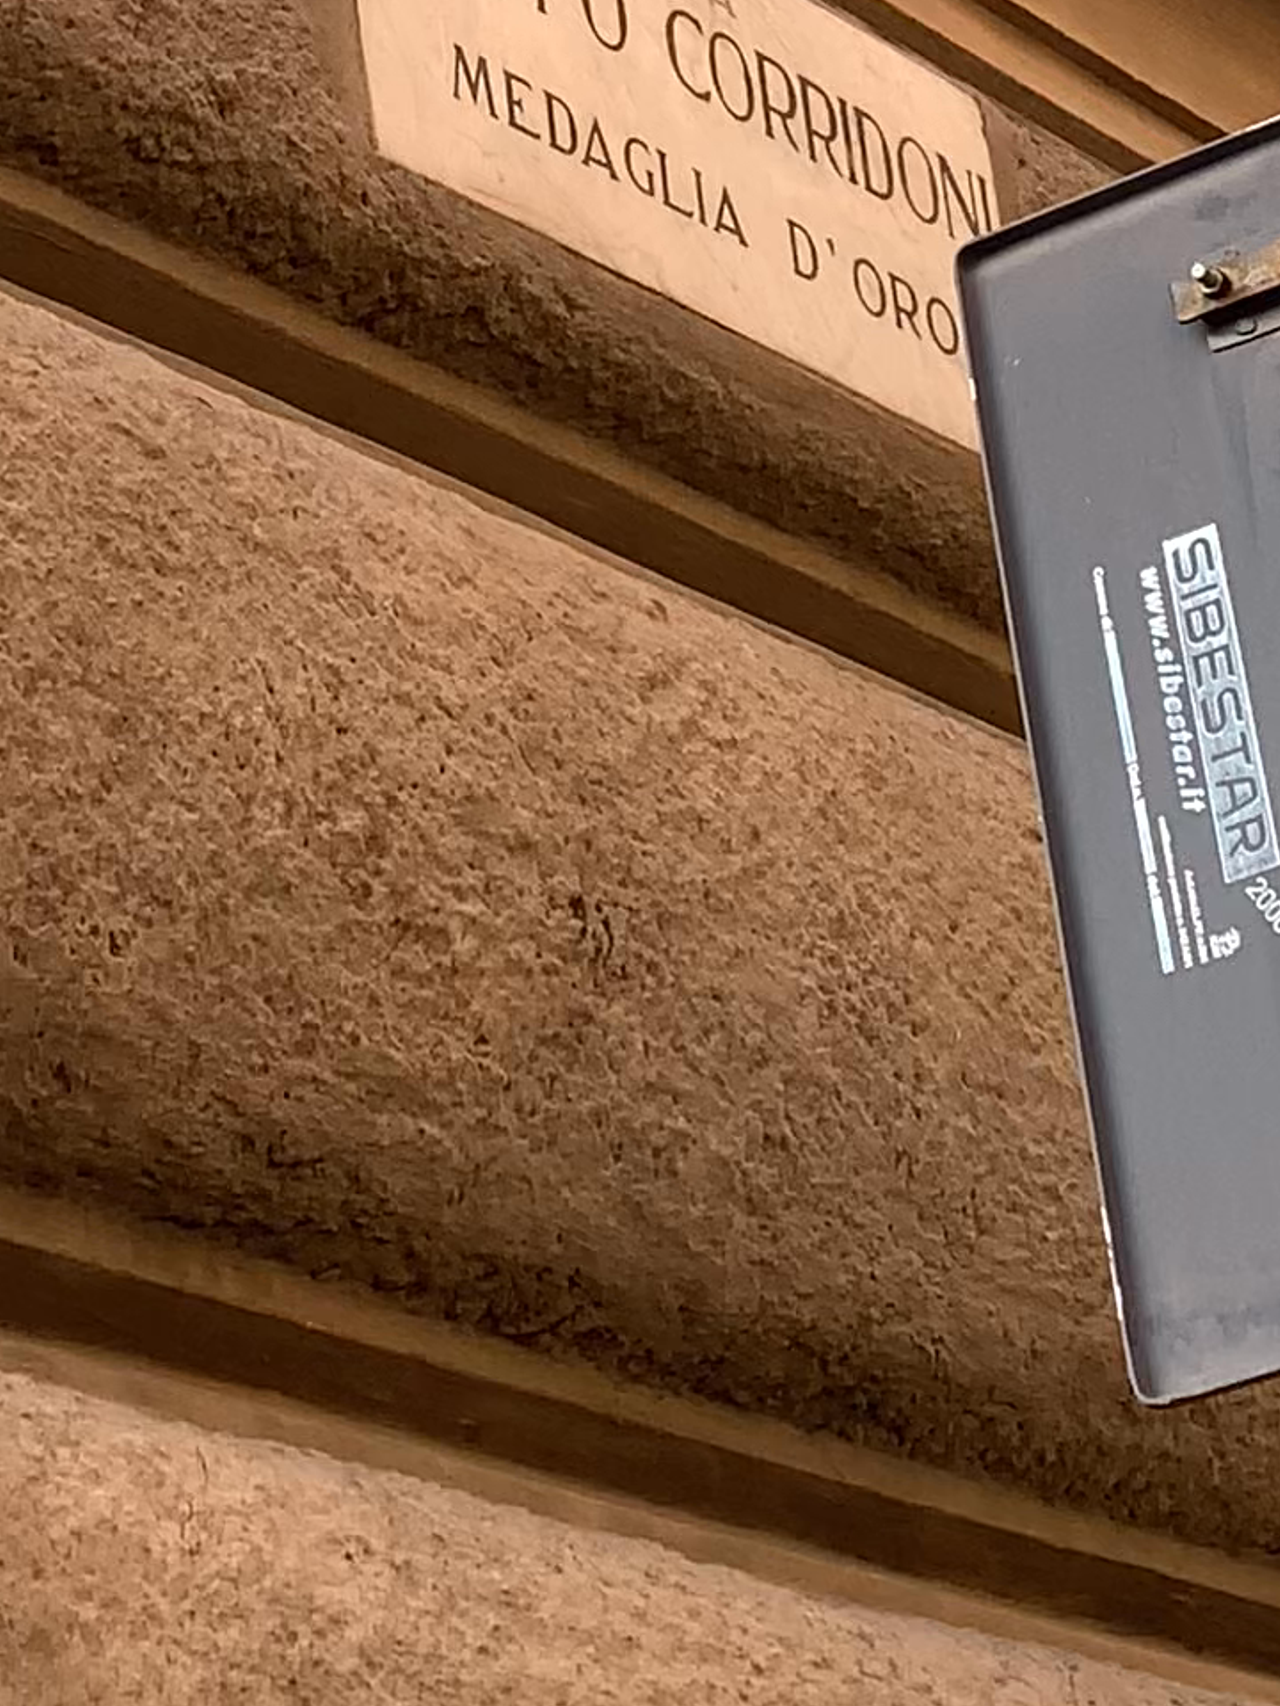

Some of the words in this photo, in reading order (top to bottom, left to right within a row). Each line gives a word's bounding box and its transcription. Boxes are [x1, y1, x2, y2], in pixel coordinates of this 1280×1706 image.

[452, 44, 749, 248] MEDAGLIA
[665, 8, 998, 239] CORRIDONI
[1139, 565, 1207, 815] www.sibestar.it
[1172, 535, 1268, 859] SIBESTAR
